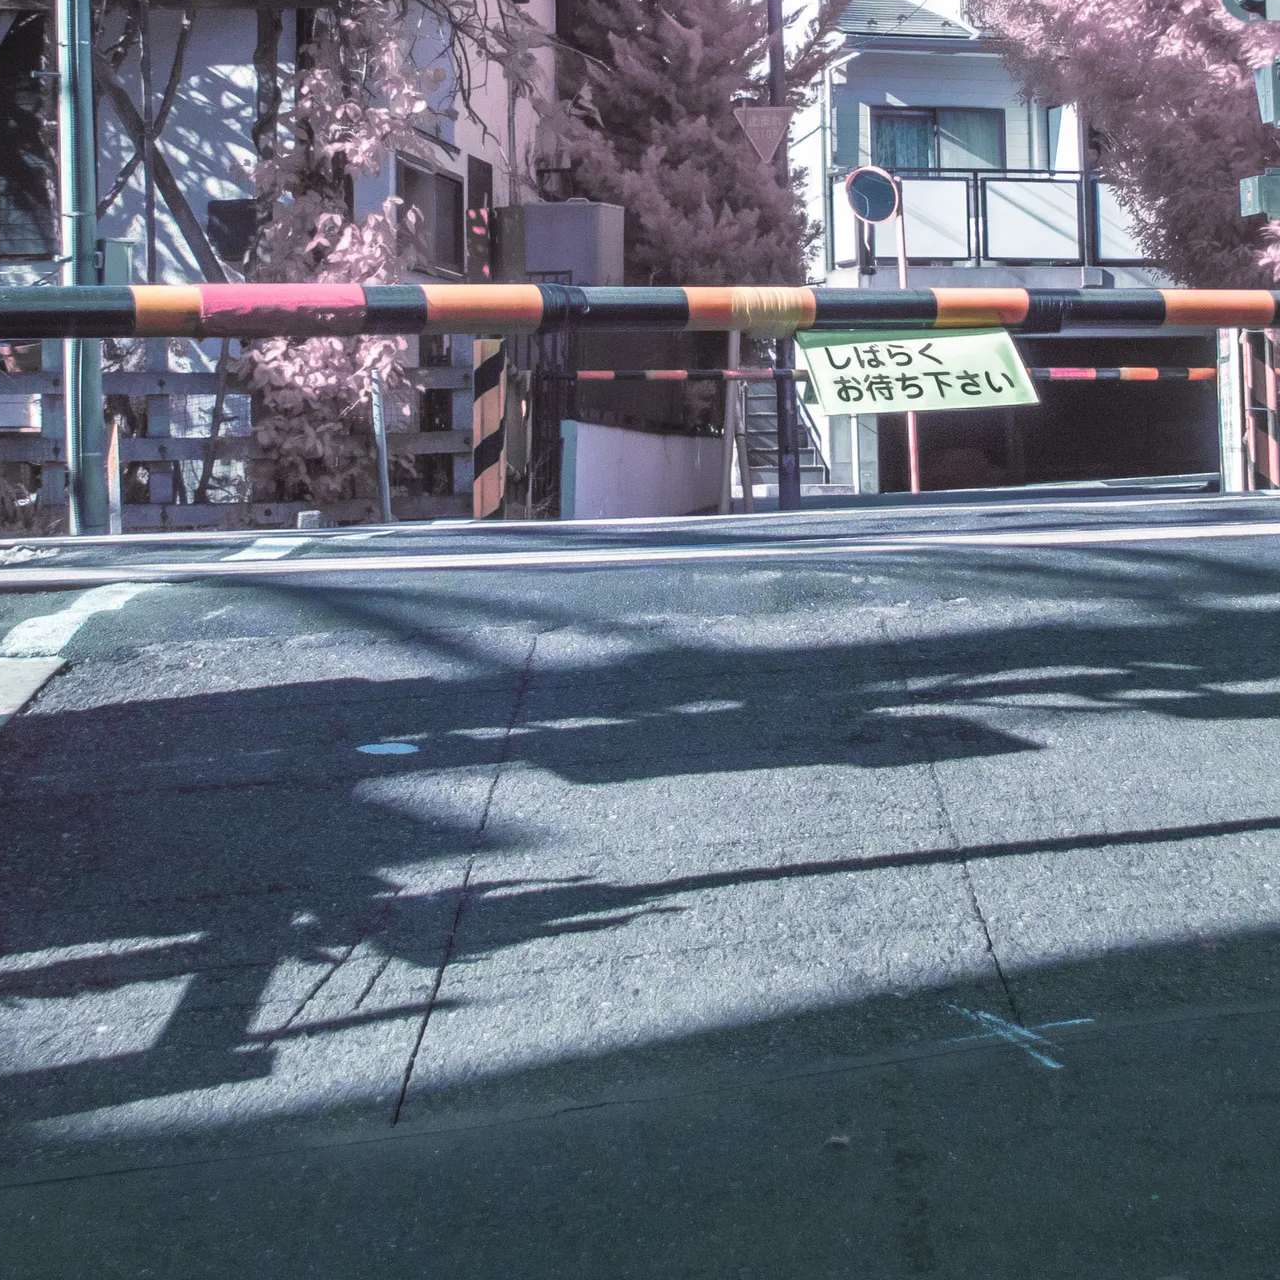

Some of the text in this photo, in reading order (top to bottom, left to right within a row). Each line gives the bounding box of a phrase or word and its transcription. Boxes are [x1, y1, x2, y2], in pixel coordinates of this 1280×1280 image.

[824, 342, 944, 370] しばらく
[833, 370, 1016, 402] お待ち下さい
